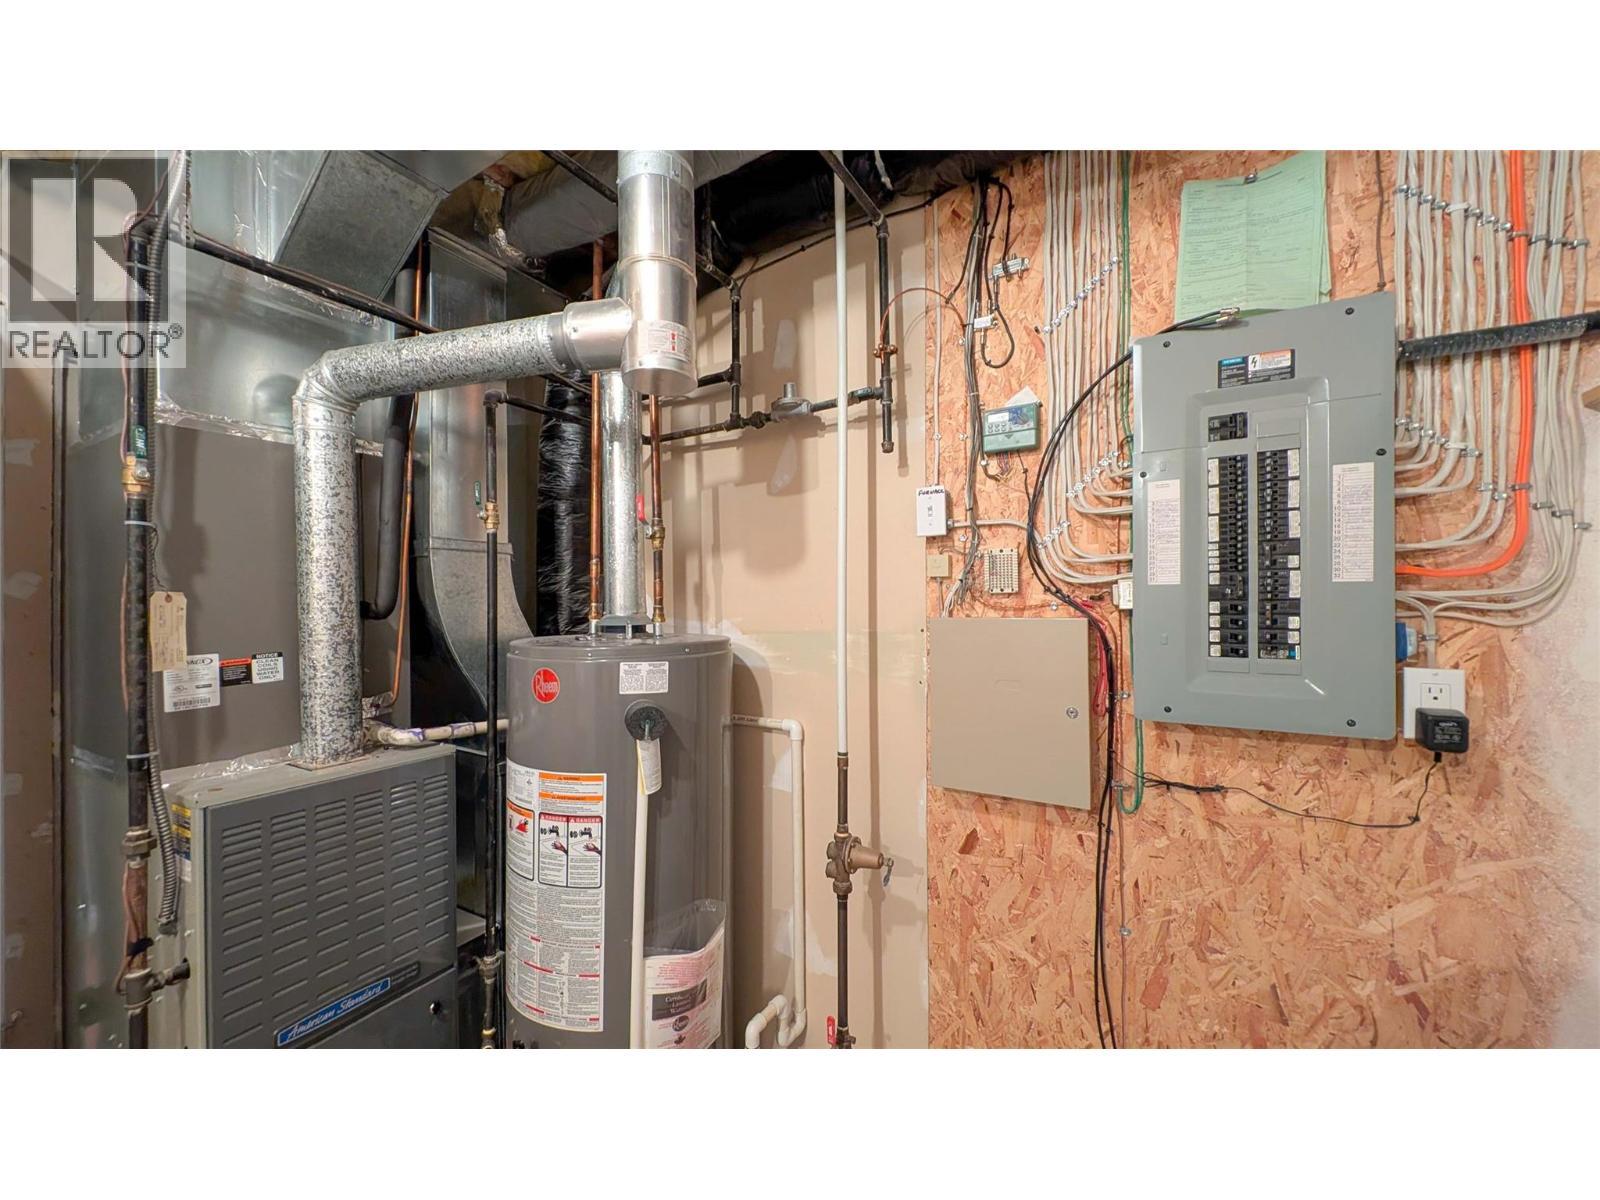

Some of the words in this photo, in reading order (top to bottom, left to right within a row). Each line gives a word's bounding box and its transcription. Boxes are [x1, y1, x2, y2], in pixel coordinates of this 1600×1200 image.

[534, 670, 558, 698] Rheem
[286, 1010, 336, 1042] American
[337, 983, 383, 1014] Standard
